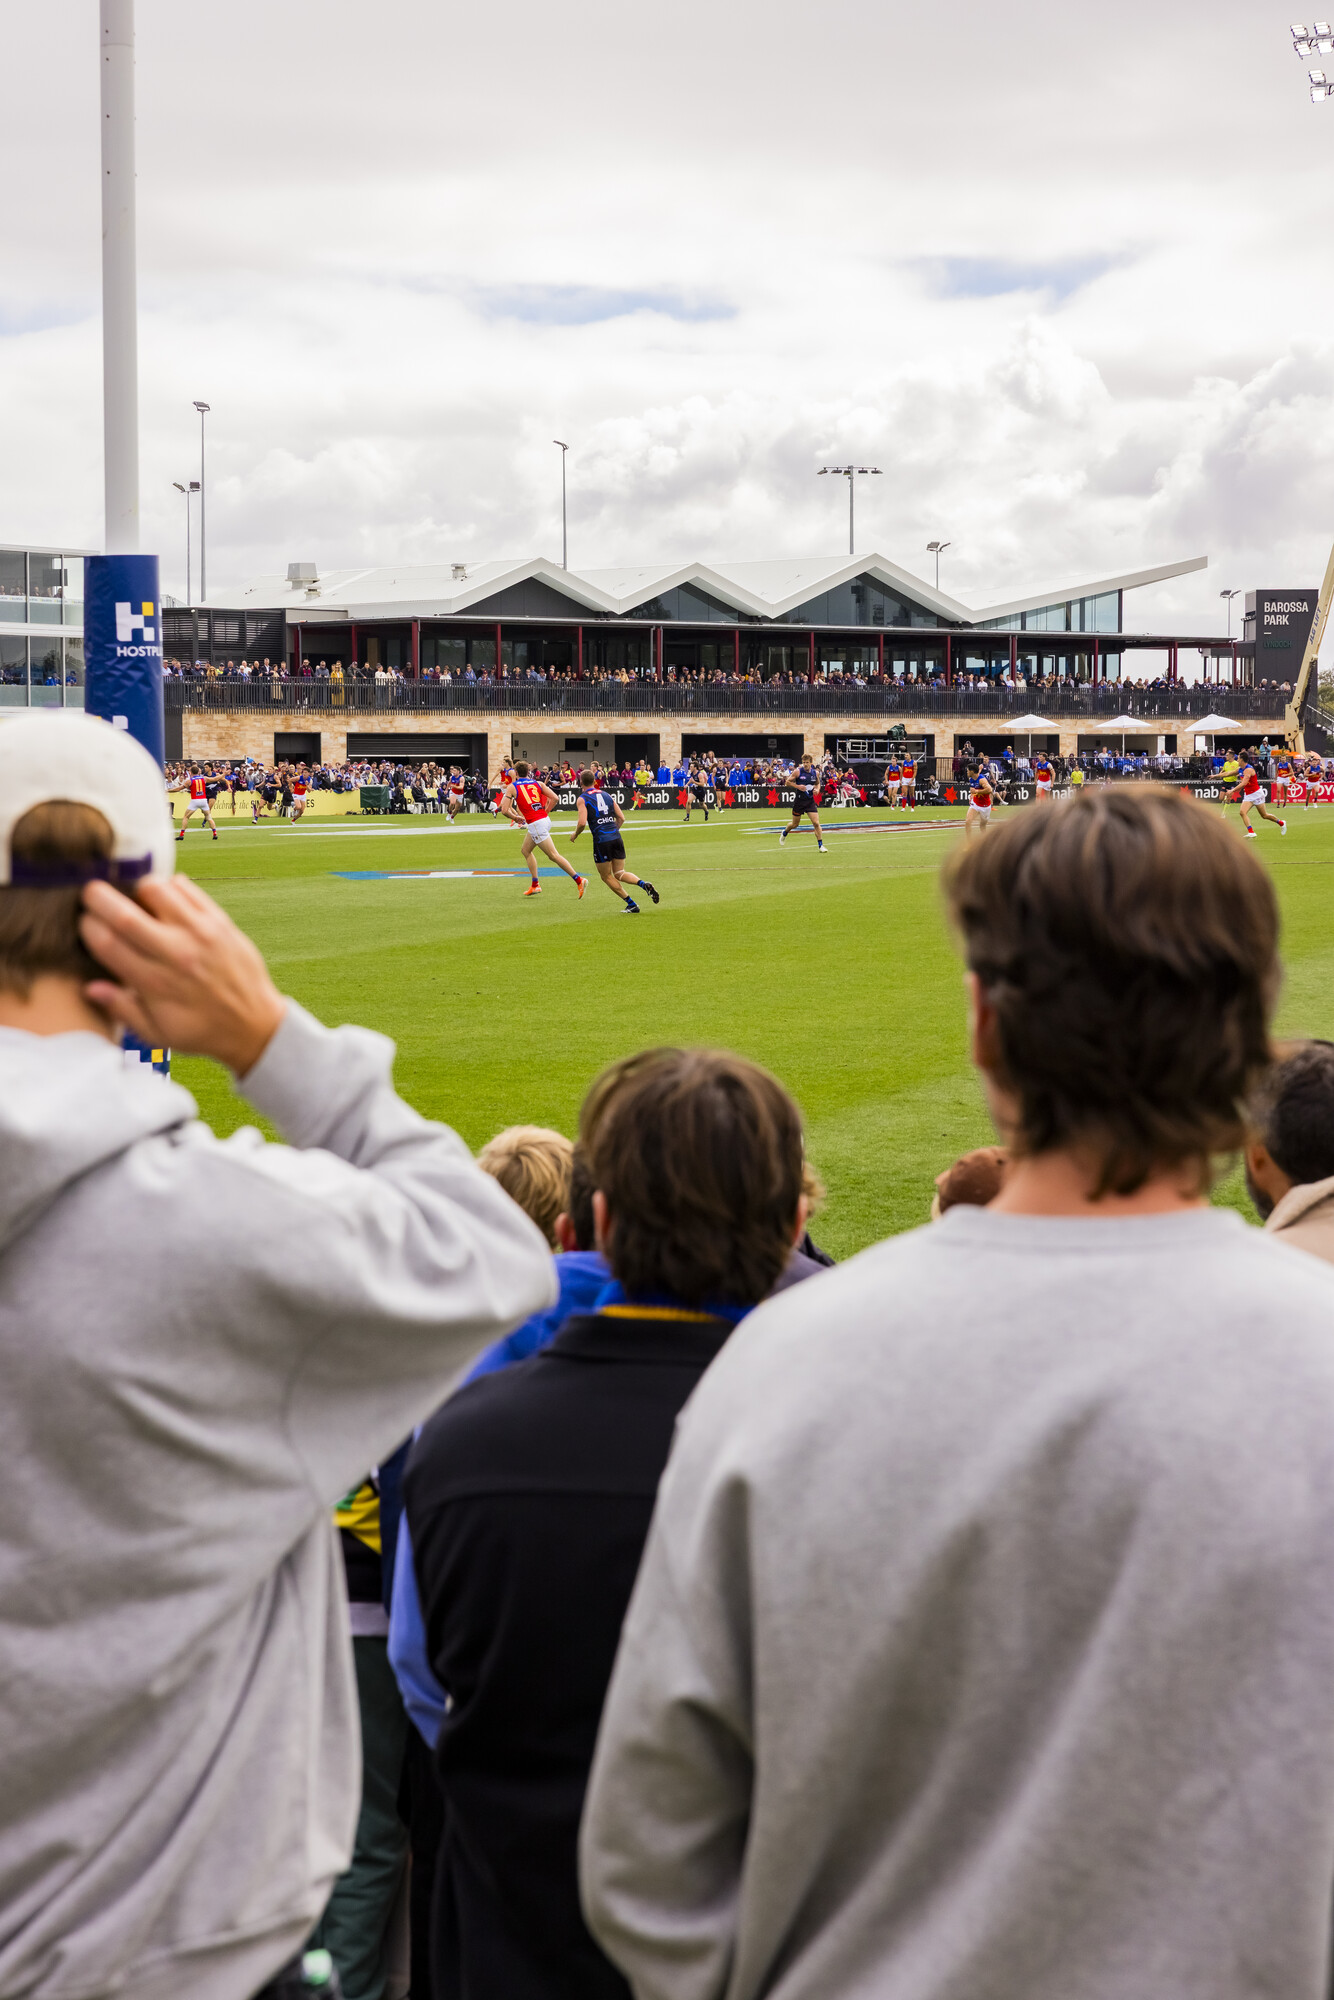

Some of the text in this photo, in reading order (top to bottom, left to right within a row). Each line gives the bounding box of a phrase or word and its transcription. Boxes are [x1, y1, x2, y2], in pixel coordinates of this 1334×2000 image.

[1264, 602, 1309, 612] BAROSSA
[1264, 615, 1290, 625] PARK
[195, 779, 203, 792] 11
[519, 784, 541, 804] 13
[647, 790, 670, 804] nab
[737, 789, 759, 803] nab
[1195, 786, 1219, 799] nab
[596, 793, 609, 814] 4
